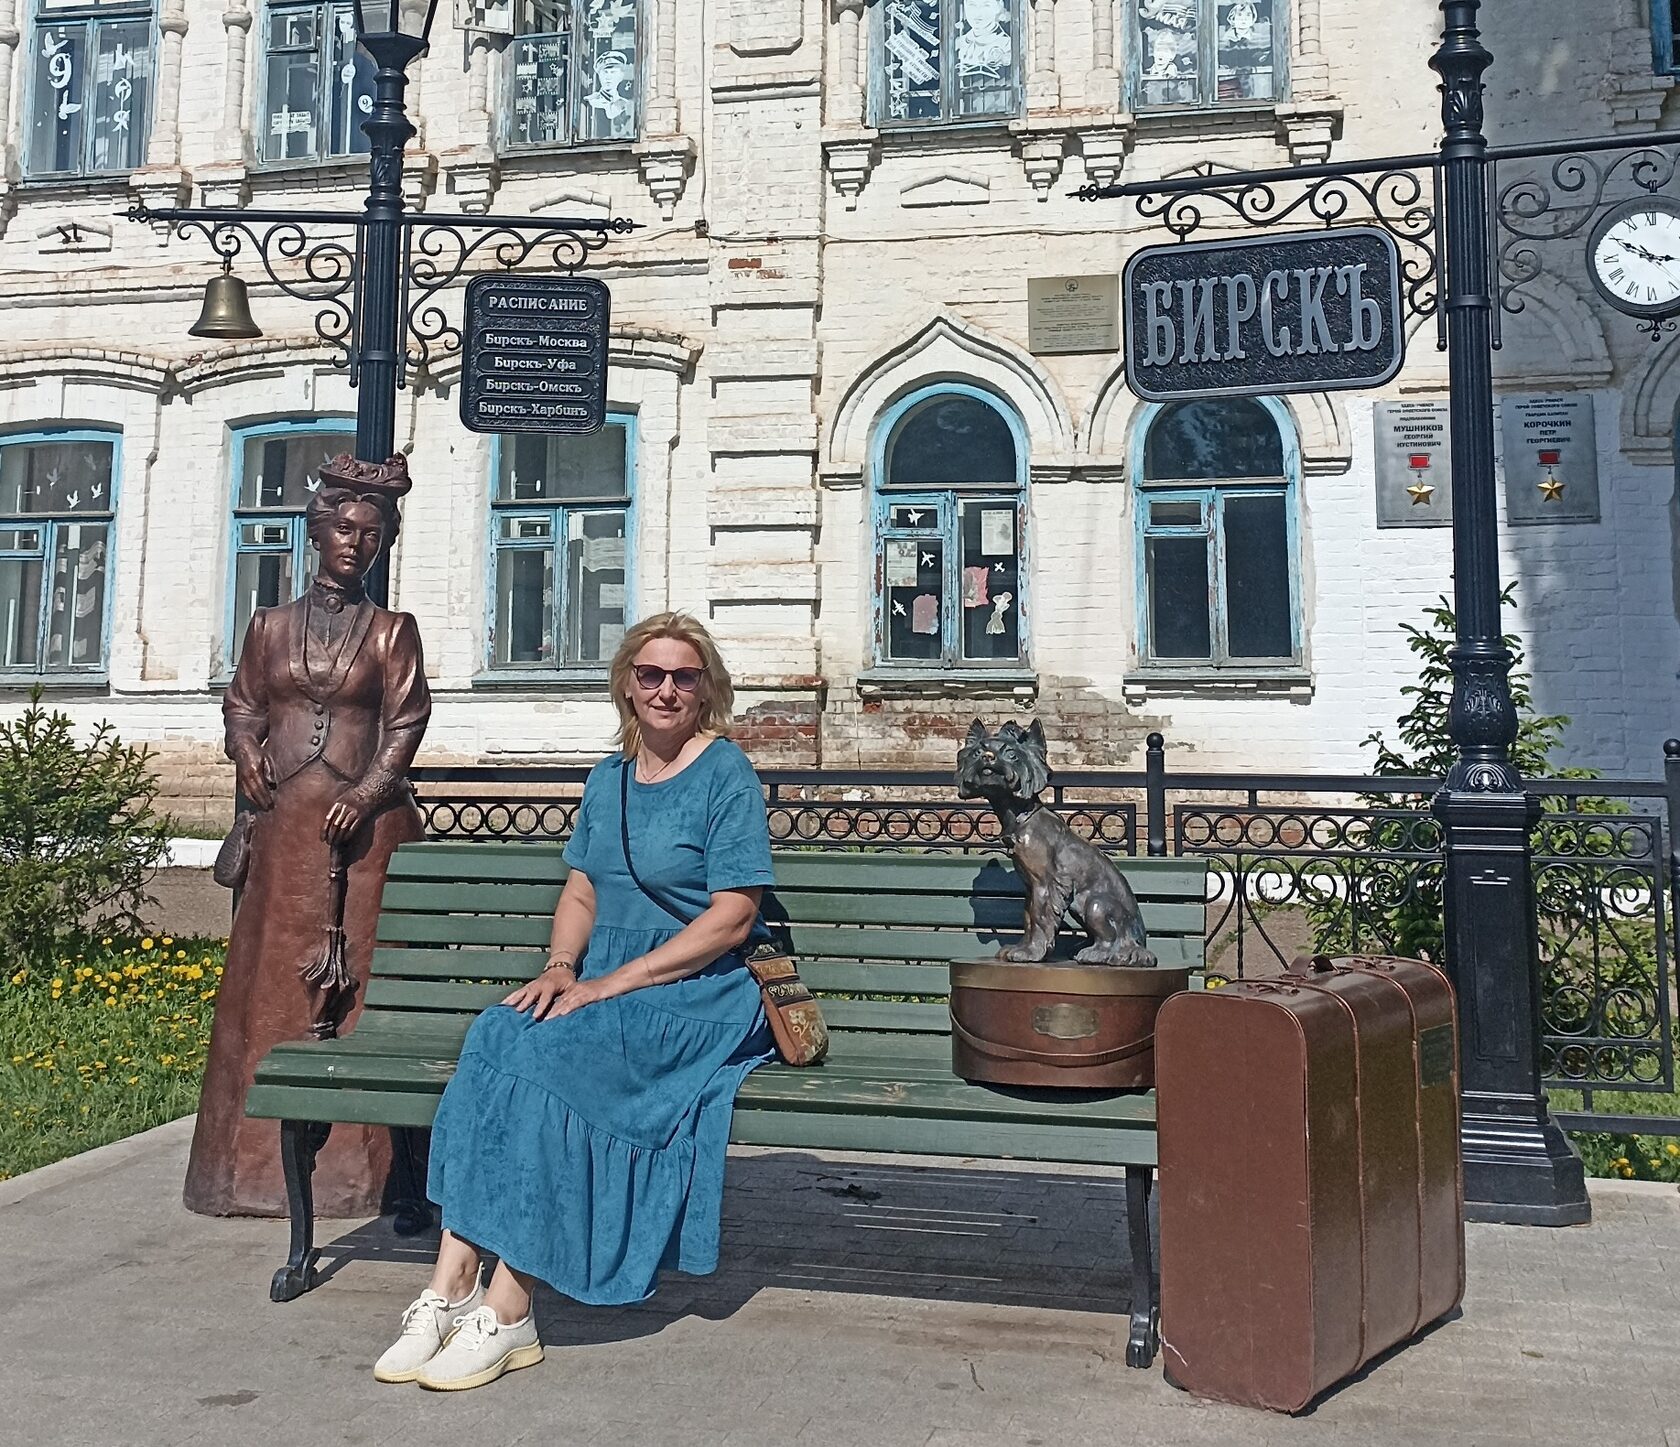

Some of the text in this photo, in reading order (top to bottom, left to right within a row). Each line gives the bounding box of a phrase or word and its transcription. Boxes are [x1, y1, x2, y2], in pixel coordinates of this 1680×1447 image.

[488, 296, 588, 311] РАСПИСАНИЕ
[1141, 263, 1383, 367] БИРСКЪ
[485, 333, 588, 348] Бирскъ-Москва
[494, 356, 577, 372] Бирскъ-Уфа
[486, 378, 582, 394] Бирскъ-Омскъ
[479, 401, 588, 417] Бирскъ-Харбинъ
[1393, 424, 1444, 433] МУШНИКОВ
[1523, 420, 1572, 428] КОРОЧКИН
